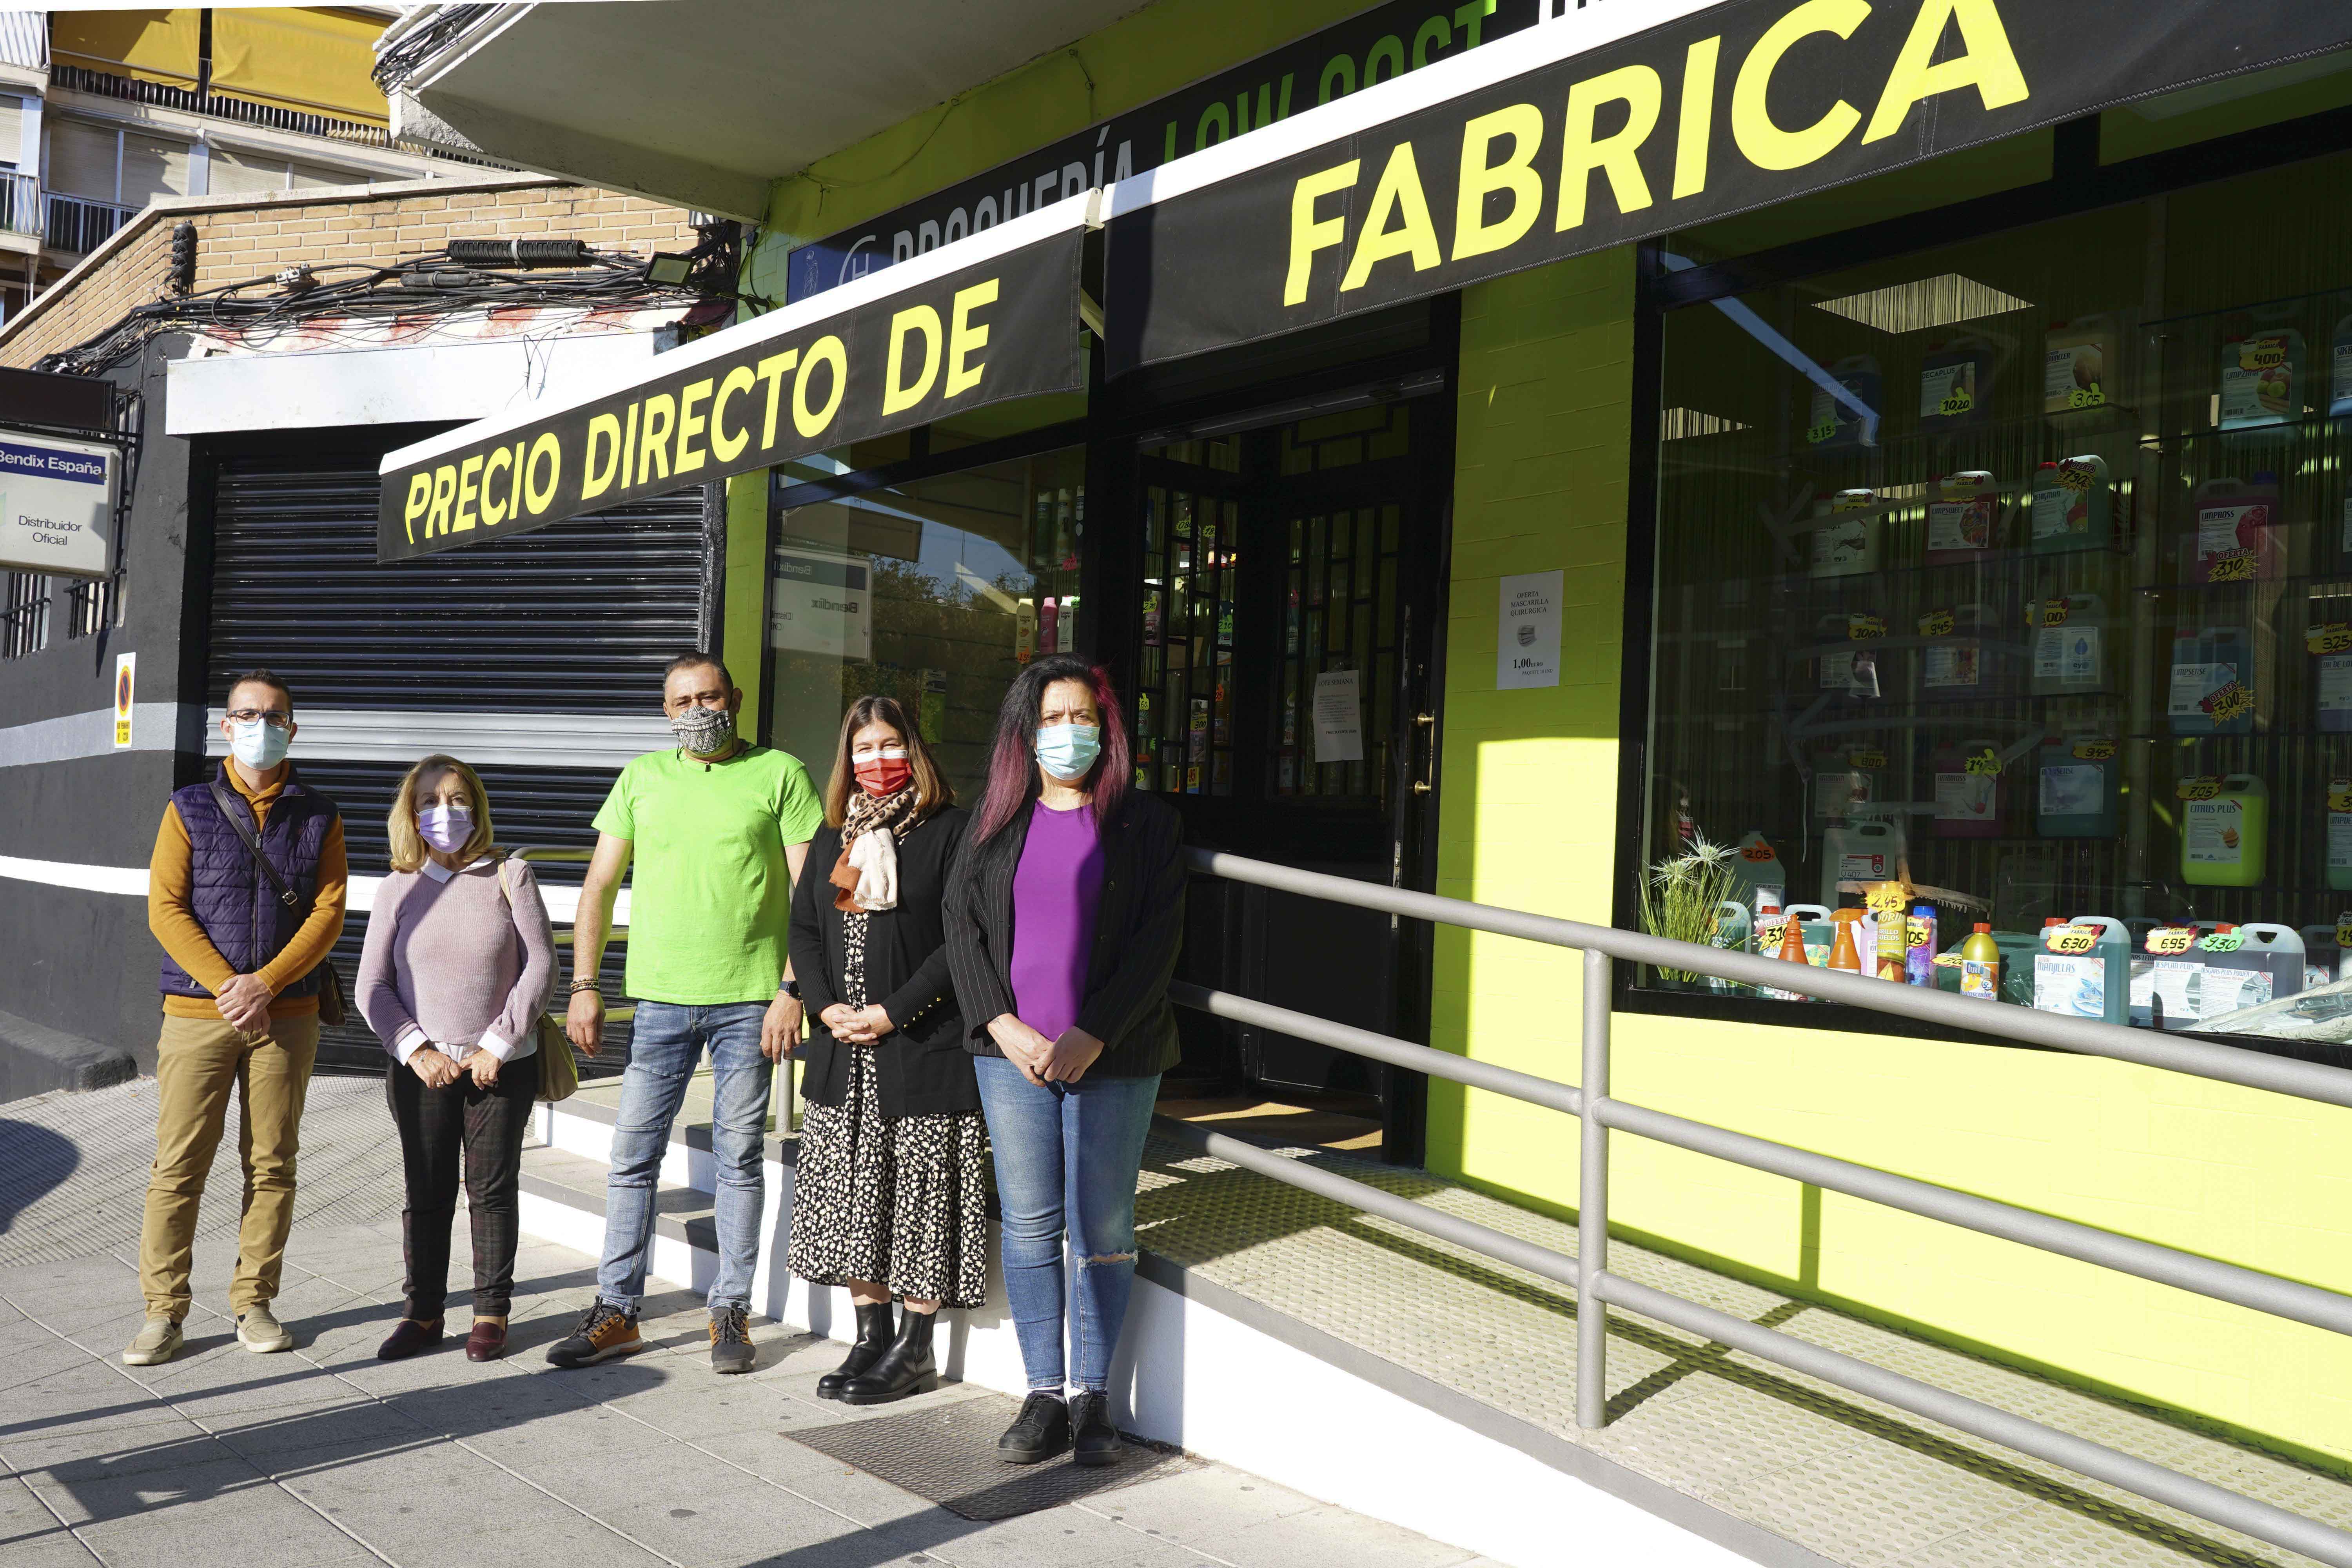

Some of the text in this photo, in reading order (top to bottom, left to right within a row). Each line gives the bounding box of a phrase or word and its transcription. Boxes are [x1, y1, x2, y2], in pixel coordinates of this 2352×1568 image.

[1284, 0, 2029, 306] FABRICA
[1922, 367, 1955, 379] DECAPLUS
[405, 279, 998, 544] PRECIO DIRECTO DE
[48, 457, 102, 475] España
[2071, 462, 2095, 472] OFERTA
[19, 515, 82, 532] Distribuidor
[33, 532, 67, 545] Oficial
[2218, 549, 2248, 559] OFERTA
[1511, 599, 1549, 607] MASCARILLA
[2210, 682, 2237, 702] OFERTA
[2190, 804, 2236, 813] CITRUS PLUS
[1907, 931, 1924, 944] 05
